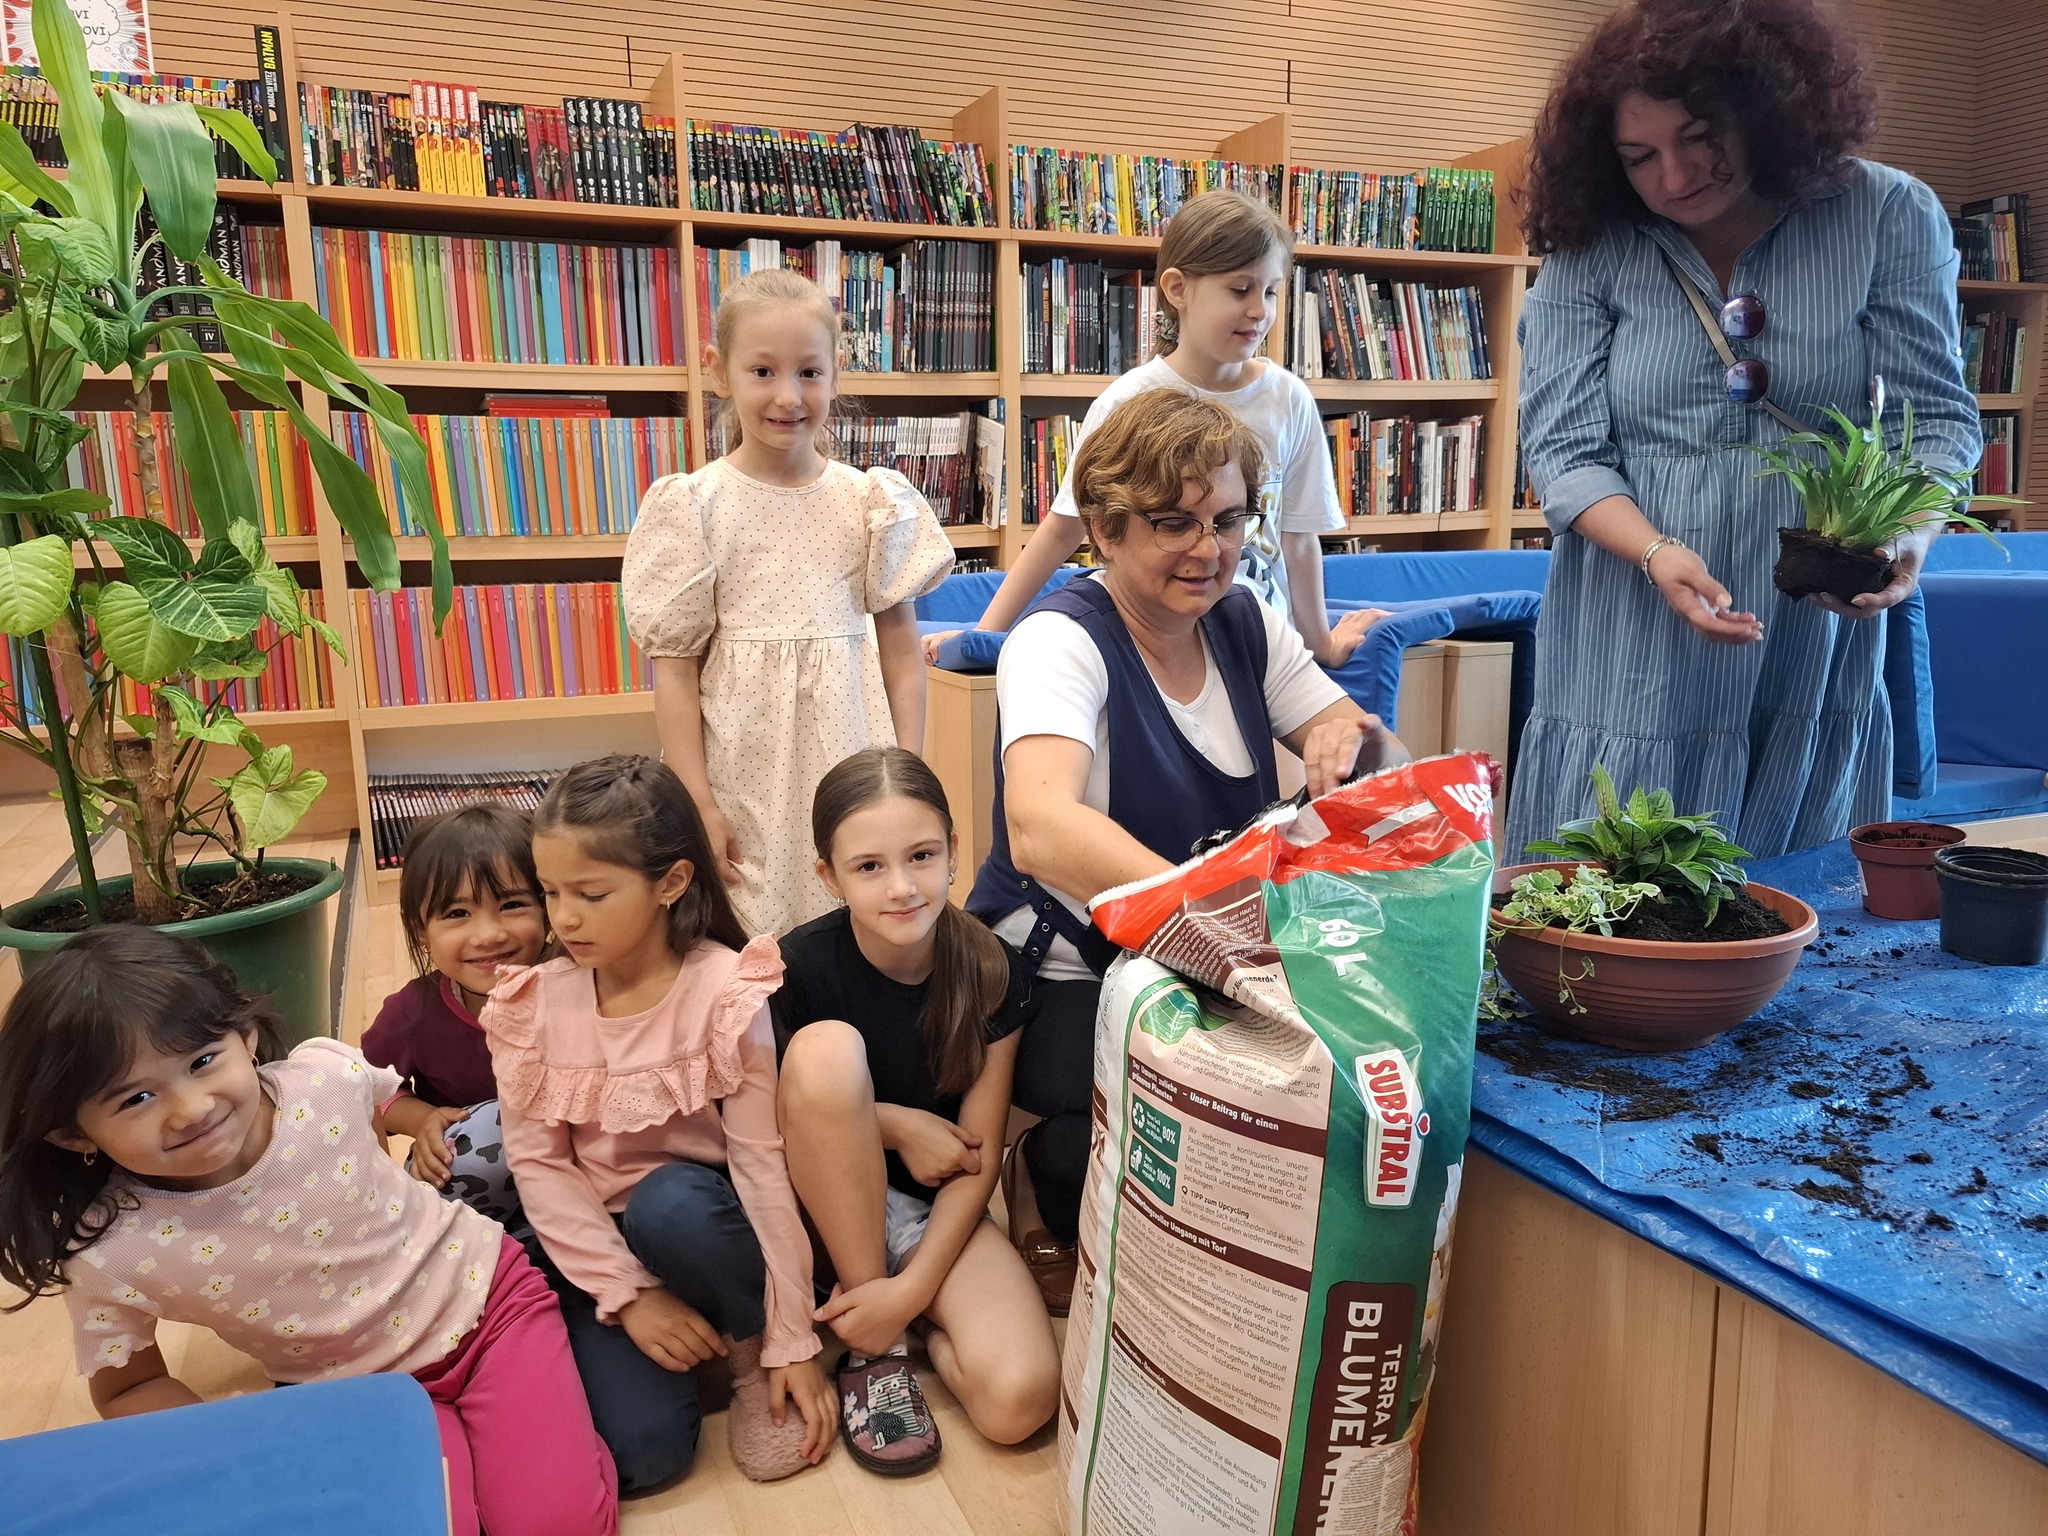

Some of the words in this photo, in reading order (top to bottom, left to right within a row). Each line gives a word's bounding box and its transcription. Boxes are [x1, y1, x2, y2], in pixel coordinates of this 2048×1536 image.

[260, 31, 276, 70] BATMAN
[434, 140, 438, 150] 2
[446, 141, 452, 151] 3
[460, 142, 466, 152] 4
[475, 144, 480, 154] 5
[205, 332, 214, 340] IV
[1240, 907, 1252, 917] Haus
[1318, 918, 1360, 948] 60
[1334, 952, 1368, 976] L
[1132, 1071, 1151, 1090] grüneren
[1151, 1084, 1173, 1102] Planeten
[1228, 1058, 1257, 1074] verbessert
[1306, 1082, 1320, 1090] und
[1232, 1070, 1244, 1080] und
[1244, 1075, 1264, 1086] gleicht
[1265, 1082, 1319, 1100] unterschiedliche
[1132, 1060, 1140, 1069] Der
[1141, 1066, 1158, 1082] Umwelt
[1158, 1078, 1178, 1094] zuliebe
[1190, 1092, 1210, 1107] Unser
[1212, 1102, 1238, 1120] Beitrag
[1240, 1112, 1253, 1123] für
[1256, 1119, 1279, 1130] einen
[1162, 1126, 1175, 1144] 80%
[1364, 1060, 1413, 1197] SUBSTRAL
[1188, 1135, 1216, 1154] Packmittel,
[1230, 1152, 1247, 1164] deren
[1249, 1160, 1294, 1178] Auswirkungen
[1297, 1174, 1308, 1182] auf
[1189, 1126, 1197, 1134] Wir
[1202, 1133, 1231, 1148] verbessern
[1236, 1145, 1279, 1164] kontinuierlich
[1286, 1162, 1308, 1172] unsere
[1157, 1168, 1171, 1190] 100%
[1184, 1174, 1214, 1191] packungen.
[1185, 1154, 1202, 1167] halten.
[1205, 1161, 1222, 1174] Daher
[1223, 1170, 1256, 1188] verwenden
[1258, 1183, 1267, 1191] wir
[1269, 1186, 1283, 1196] zum
[1286, 1189, 1305, 1201] Groß-
[1185, 1164, 1193, 1172] teil
[1194, 1167, 1218, 1183] Altplastik
[1219, 1179, 1230, 1189] und
[1232, 1183, 1289, 1207] wiederverwertbare
[1290, 1201, 1304, 1210] Ver-
[1186, 1145, 1194, 1153] die
[1197, 1148, 1219, 1164] Umwelt
[1232, 1163, 1250, 1176] gering
[1253, 1170, 1264, 1180] wie
[1268, 1175, 1294, 1188] möglich
[1298, 1184, 1306, 1192] zu
[1181, 1196, 1188, 1204] Du
[1188, 1199, 1204, 1211] kannst
[1205, 1206, 1215, 1215] den
[1216, 1209, 1228, 1220] Sack
[1229, 1215, 1266, 1234] aufschneiden
[1266, 1228, 1277, 1237] und
[1278, 1231, 1286, 1240] als
[1287, 1235, 1306, 1247] Mulch-
[1190, 1190, 1203, 1200] TIPP
[1204, 1197, 1217, 1207] zum
[1218, 1201, 1249, 1219] Upcycling
[1170, 1222, 1197, 1243] Umgang
[1198, 1236, 1210, 1248] mit
[1211, 1242, 1227, 1255] Torf
[1181, 1206, 1192, 1217] folie
[1193, 1210, 1199, 1218] in
[1199, 1214, 1220, 1227] deinem
[1222, 1222, 1241, 1235] Garten
[1243, 1230, 1299, 1256] wiederverwenden.
[1168, 1250, 1186, 1264] Biotope
[1187, 1261, 1216, 1279] entwickeln.
[1176, 1245, 1186, 1255] den
[1209, 1261, 1223, 1273] nach
[1225, 1269, 1238, 1279] dem
[1240, 1274, 1270, 1292] Torfabbau
[1272, 1286, 1298, 1303] lebende
[1187, 1279, 1241, 1313] Wiedereingliederung
[1243, 1308, 1253, 1317] der
[1254, 1312, 1265, 1322] von
[1267, 1318, 1278, 1328] uns
[1280, 1324, 1292, 1332] ver-
[1192, 1292, 1214, 1308] Biotopen
[1232, 1312, 1279, 1338] Naturlandschaft
[1280, 1334, 1291, 1343] ge-
[1198, 1277, 1208, 1285] den
[1211, 1282, 1272, 1314] Naturschutzbehörden
[1276, 1309, 1294, 1322] Land-
[1209, 1312, 1232, 1328] mehrere
[1247, 1329, 1290, 1353] Quadratmeter
[1206, 1331, 1216, 1340] mit
[1217, 1337, 1229, 1347] dem
[1230, 1344, 1258, 1361] endlichen
[1260, 1356, 1287, 1373] Rohstoff
[1186, 1360, 1213, 1380] ermöglicht
[1221, 1381, 1231, 1389] uns
[1232, 1384, 1281, 1412] bedarfsgerechte
[1206, 1381, 1235, 1400] sukzessive
[1212, 1354, 1241, 1374] Holzfasern
[1244, 1371, 1256, 1381] und
[1258, 1376, 1284, 1391] Rinden-
[1252, 1364, 1285, 1383] Alternative
[1373, 1344, 1402, 1428] TERRA
[1188, 1442, 1212, 1463] Gebrauch
[1238, 1476, 1248, 1488] und
[1215, 1451, 1223, 1460] Für
[1224, 1455, 1232, 1466] die
[1233, 1463, 1267, 1489] Anwendung
[1235, 1508, 1256, 1524] Hobby-
